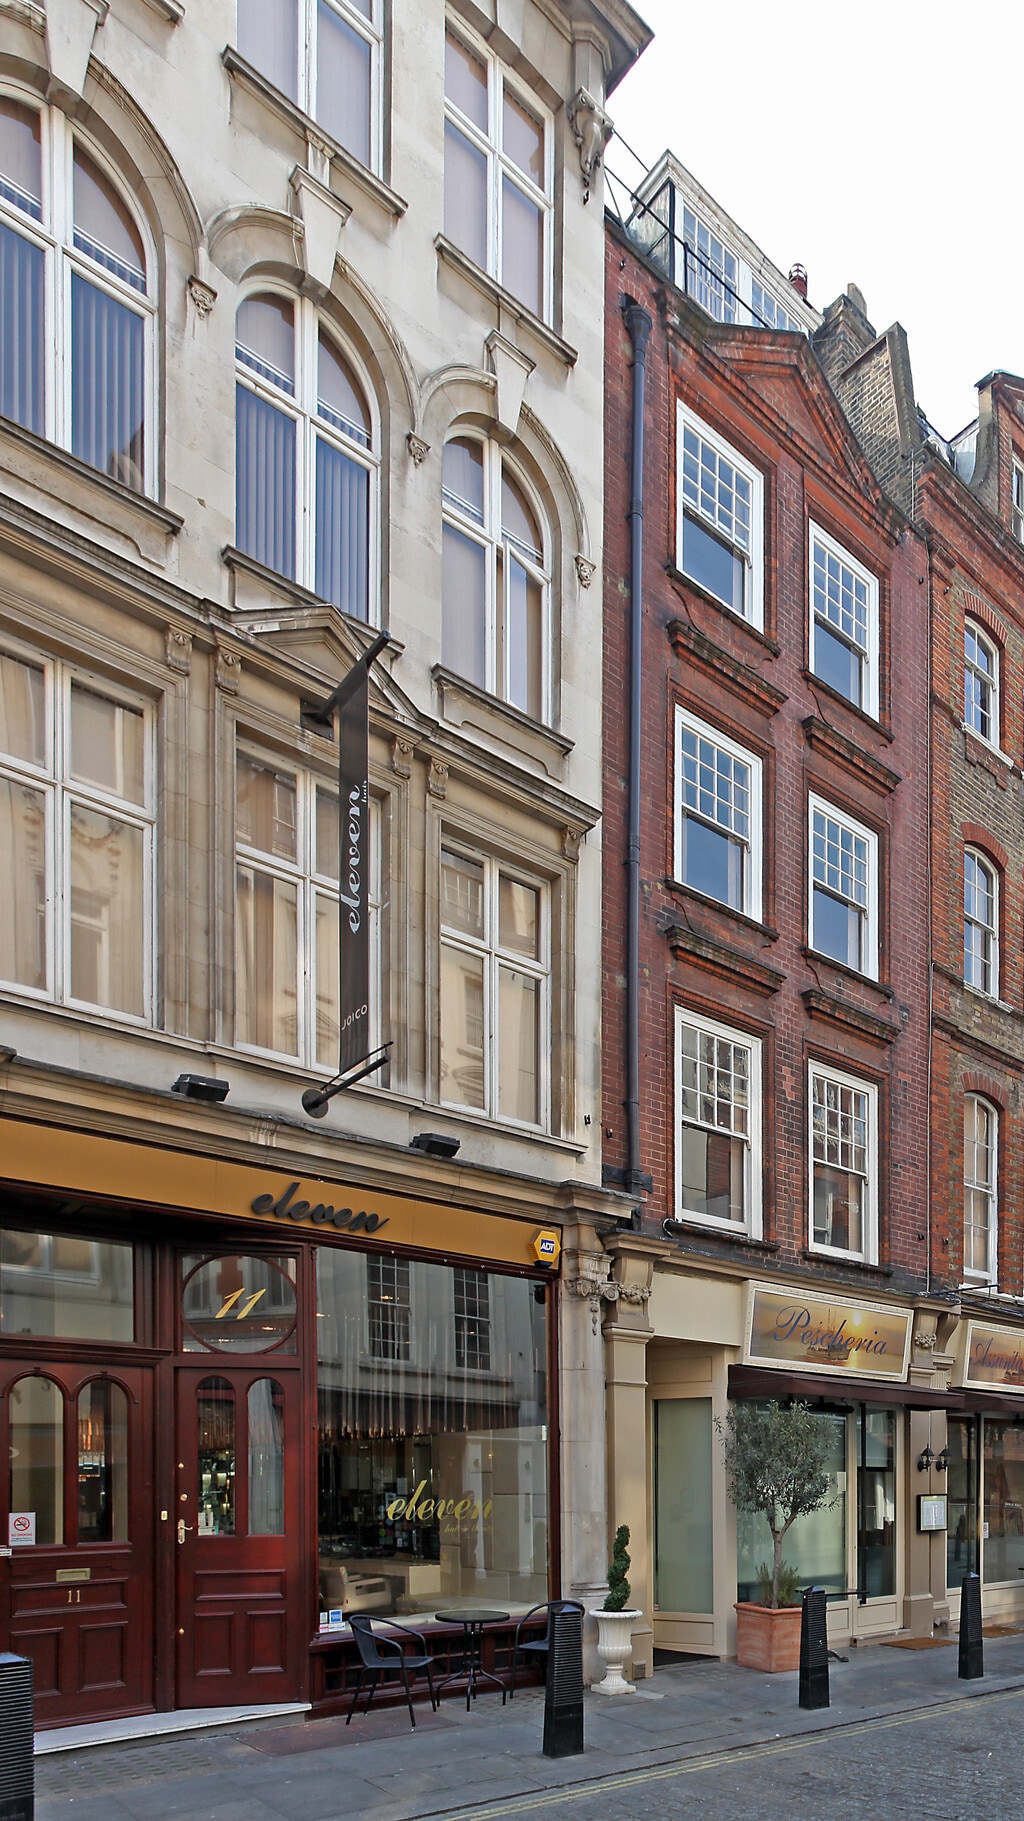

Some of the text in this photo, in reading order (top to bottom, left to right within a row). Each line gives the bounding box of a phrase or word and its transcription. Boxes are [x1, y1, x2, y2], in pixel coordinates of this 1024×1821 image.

[340, 784, 361, 935] eleven
[341, 1004, 368, 1031] JOICO
[251, 1182, 390, 1232] eleven
[540, 1242, 555, 1252] ADT
[215, 1287, 267, 1320] 11
[772, 1305, 888, 1356] Pescheria
[968, 1337, 1024, 1371] Assunta
[386, 1480, 493, 1521] eleven
[67, 1589, 81, 1603] 11
